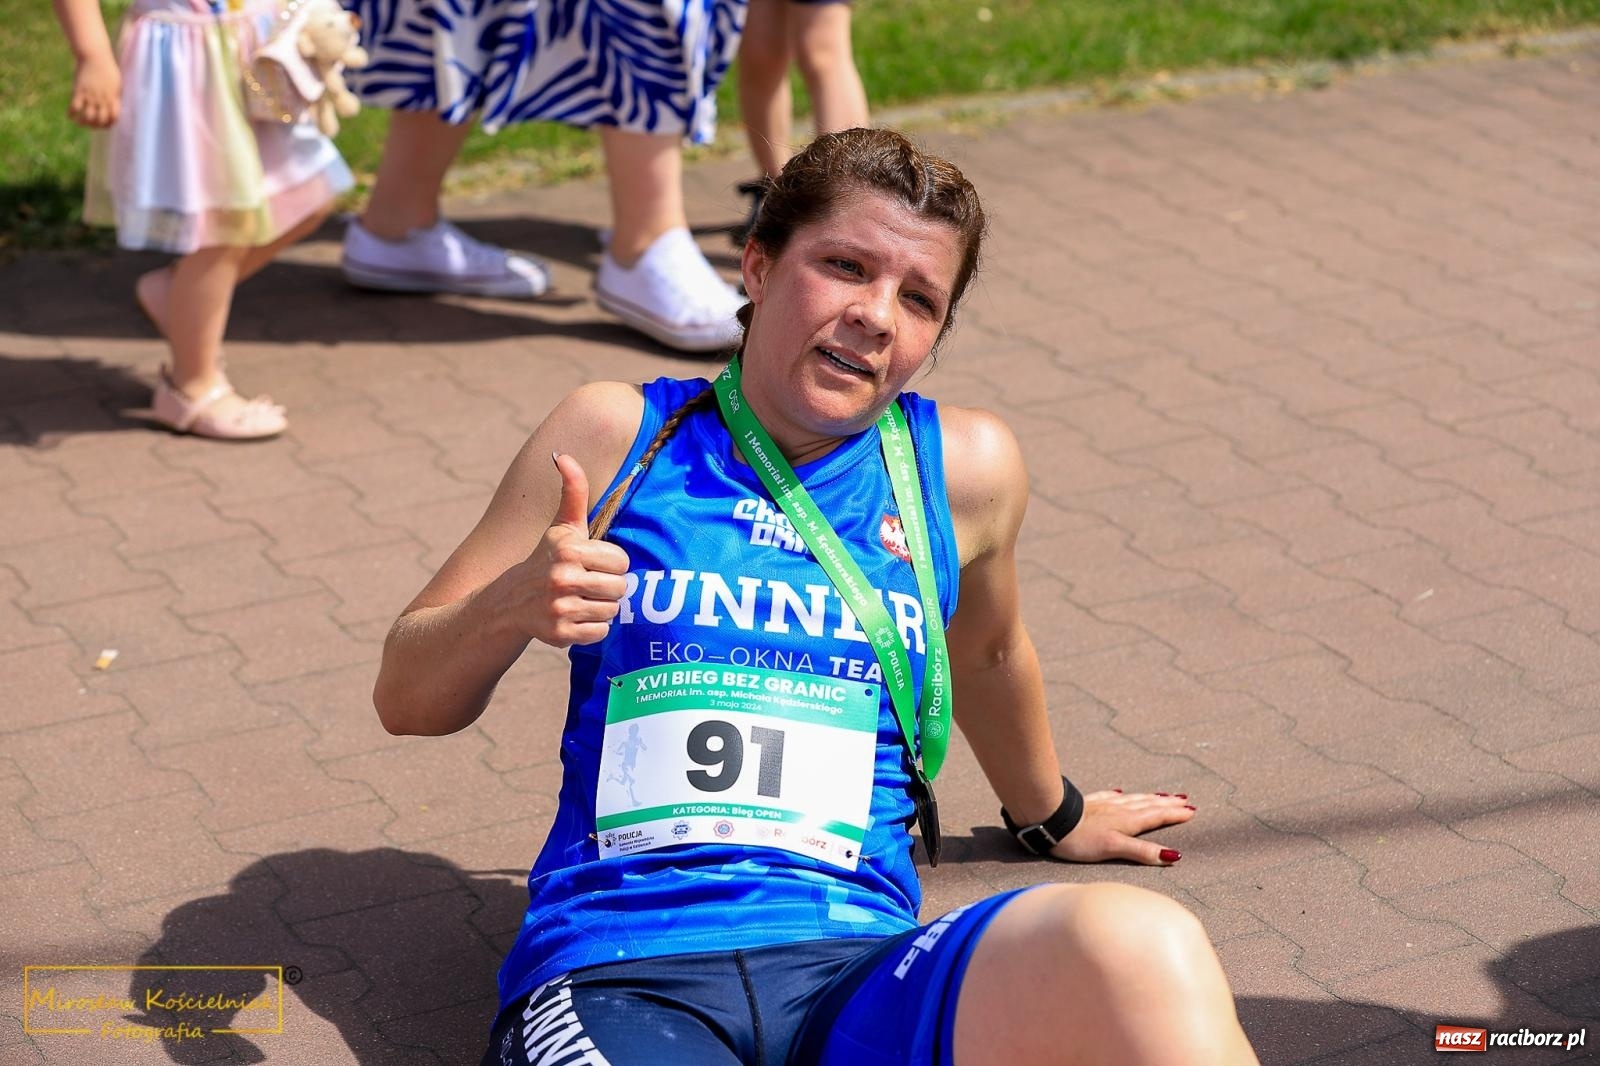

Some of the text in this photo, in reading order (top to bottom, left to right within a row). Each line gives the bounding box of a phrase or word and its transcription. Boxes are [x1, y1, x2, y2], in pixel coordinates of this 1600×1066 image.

[749, 436, 786, 485] Memoriał
[635, 670, 847, 702] XVI BIEG BEZ GRANIC
[887, 650, 905, 691] POLICJA
[928, 647, 943, 717] Racibórz
[640, 688, 688, 703] MEMORIAŁ
[689, 687, 706, 696] im.
[707, 689, 729, 699] asp.
[716, 700, 740, 709] maja
[685, 719, 785, 798] 91
[672, 805, 783, 820] KATEGORIA: Bieg OPEN
[617, 829, 643, 842] POLICJA
